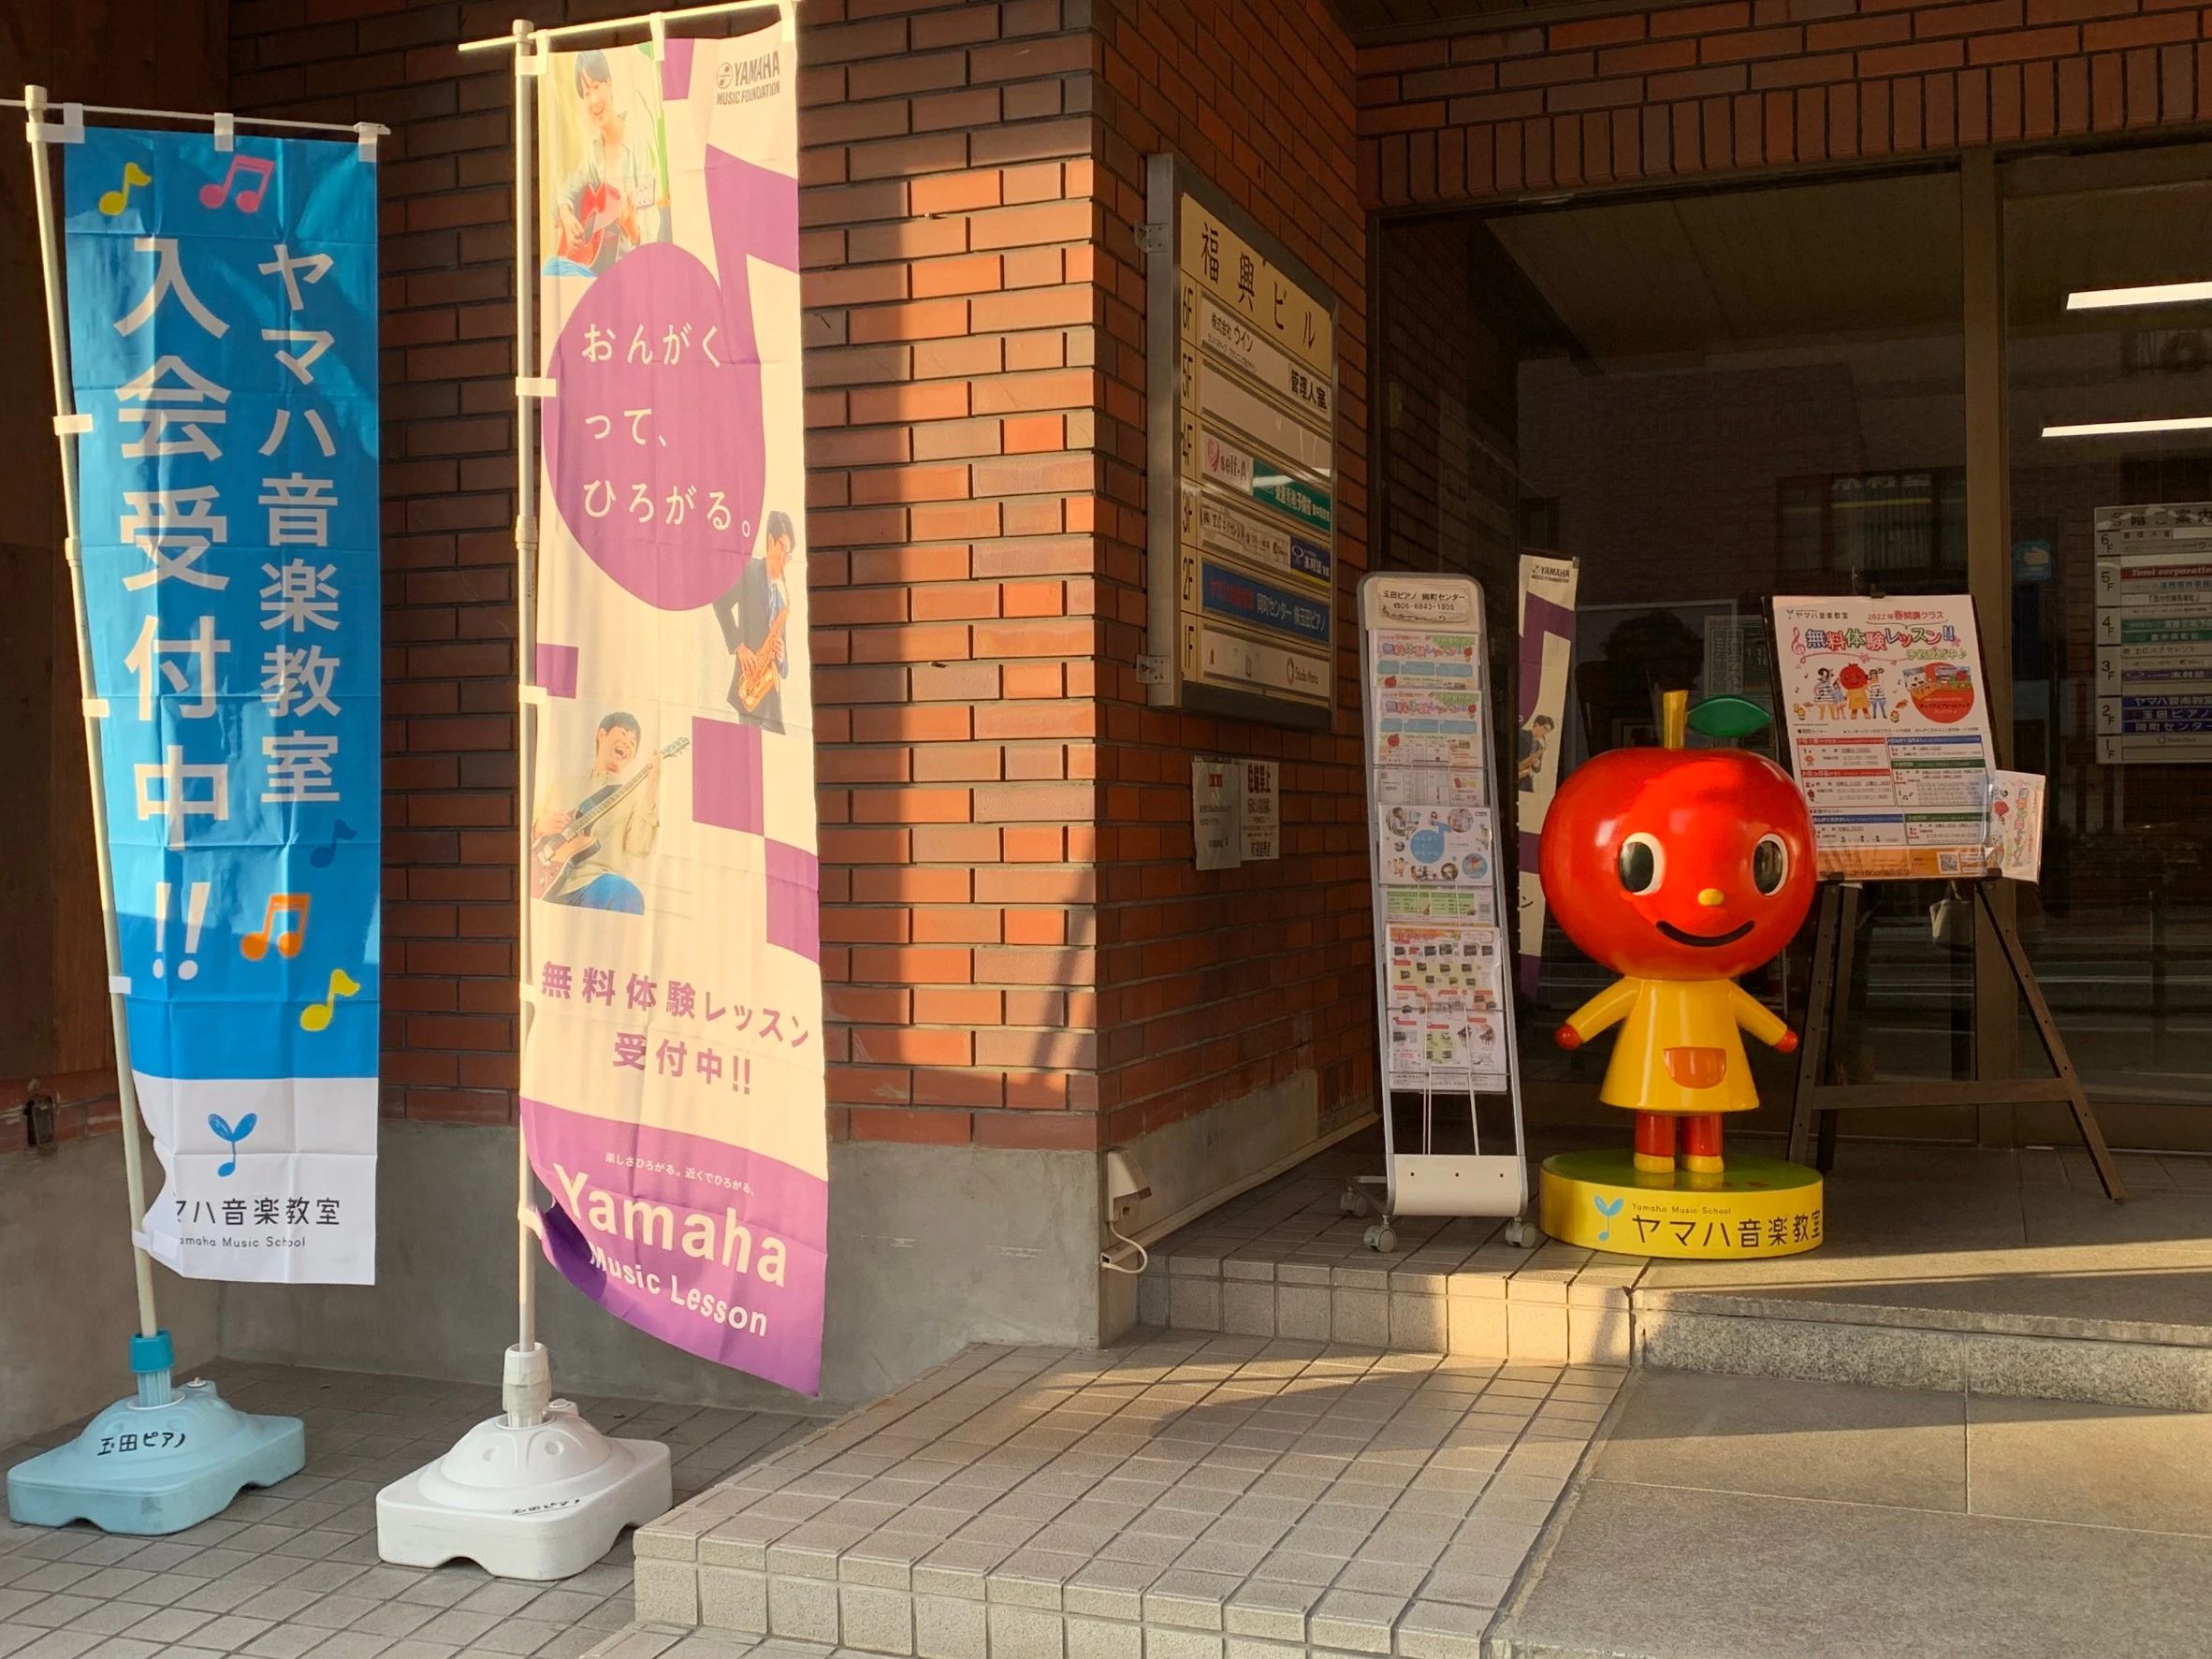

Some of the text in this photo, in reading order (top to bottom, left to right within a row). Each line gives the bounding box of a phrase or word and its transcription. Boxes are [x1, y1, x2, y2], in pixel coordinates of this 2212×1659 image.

[735, 51, 780, 86] YAMAHA
[716, 80, 780, 105] MUSIC FOUNDATION
[1201, 222, 1316, 349] 福興ビル
[582, 321, 722, 370] おんがく
[258, 243, 342, 802] ヤマハ音楽教室
[542, 961, 809, 1049] 無料体験レッスン
[553, 1162, 787, 1288] Yamaha
[1631, 1208, 1822, 1248] ヤマハ音楽教室
[1632, 1201, 1732, 1215] Yamaha Music School
[222, 1236, 259, 1248] Music
[588, 1241, 768, 1337] Music Lesson
[96, 1431, 186, 1457] 玉田ピアノ
